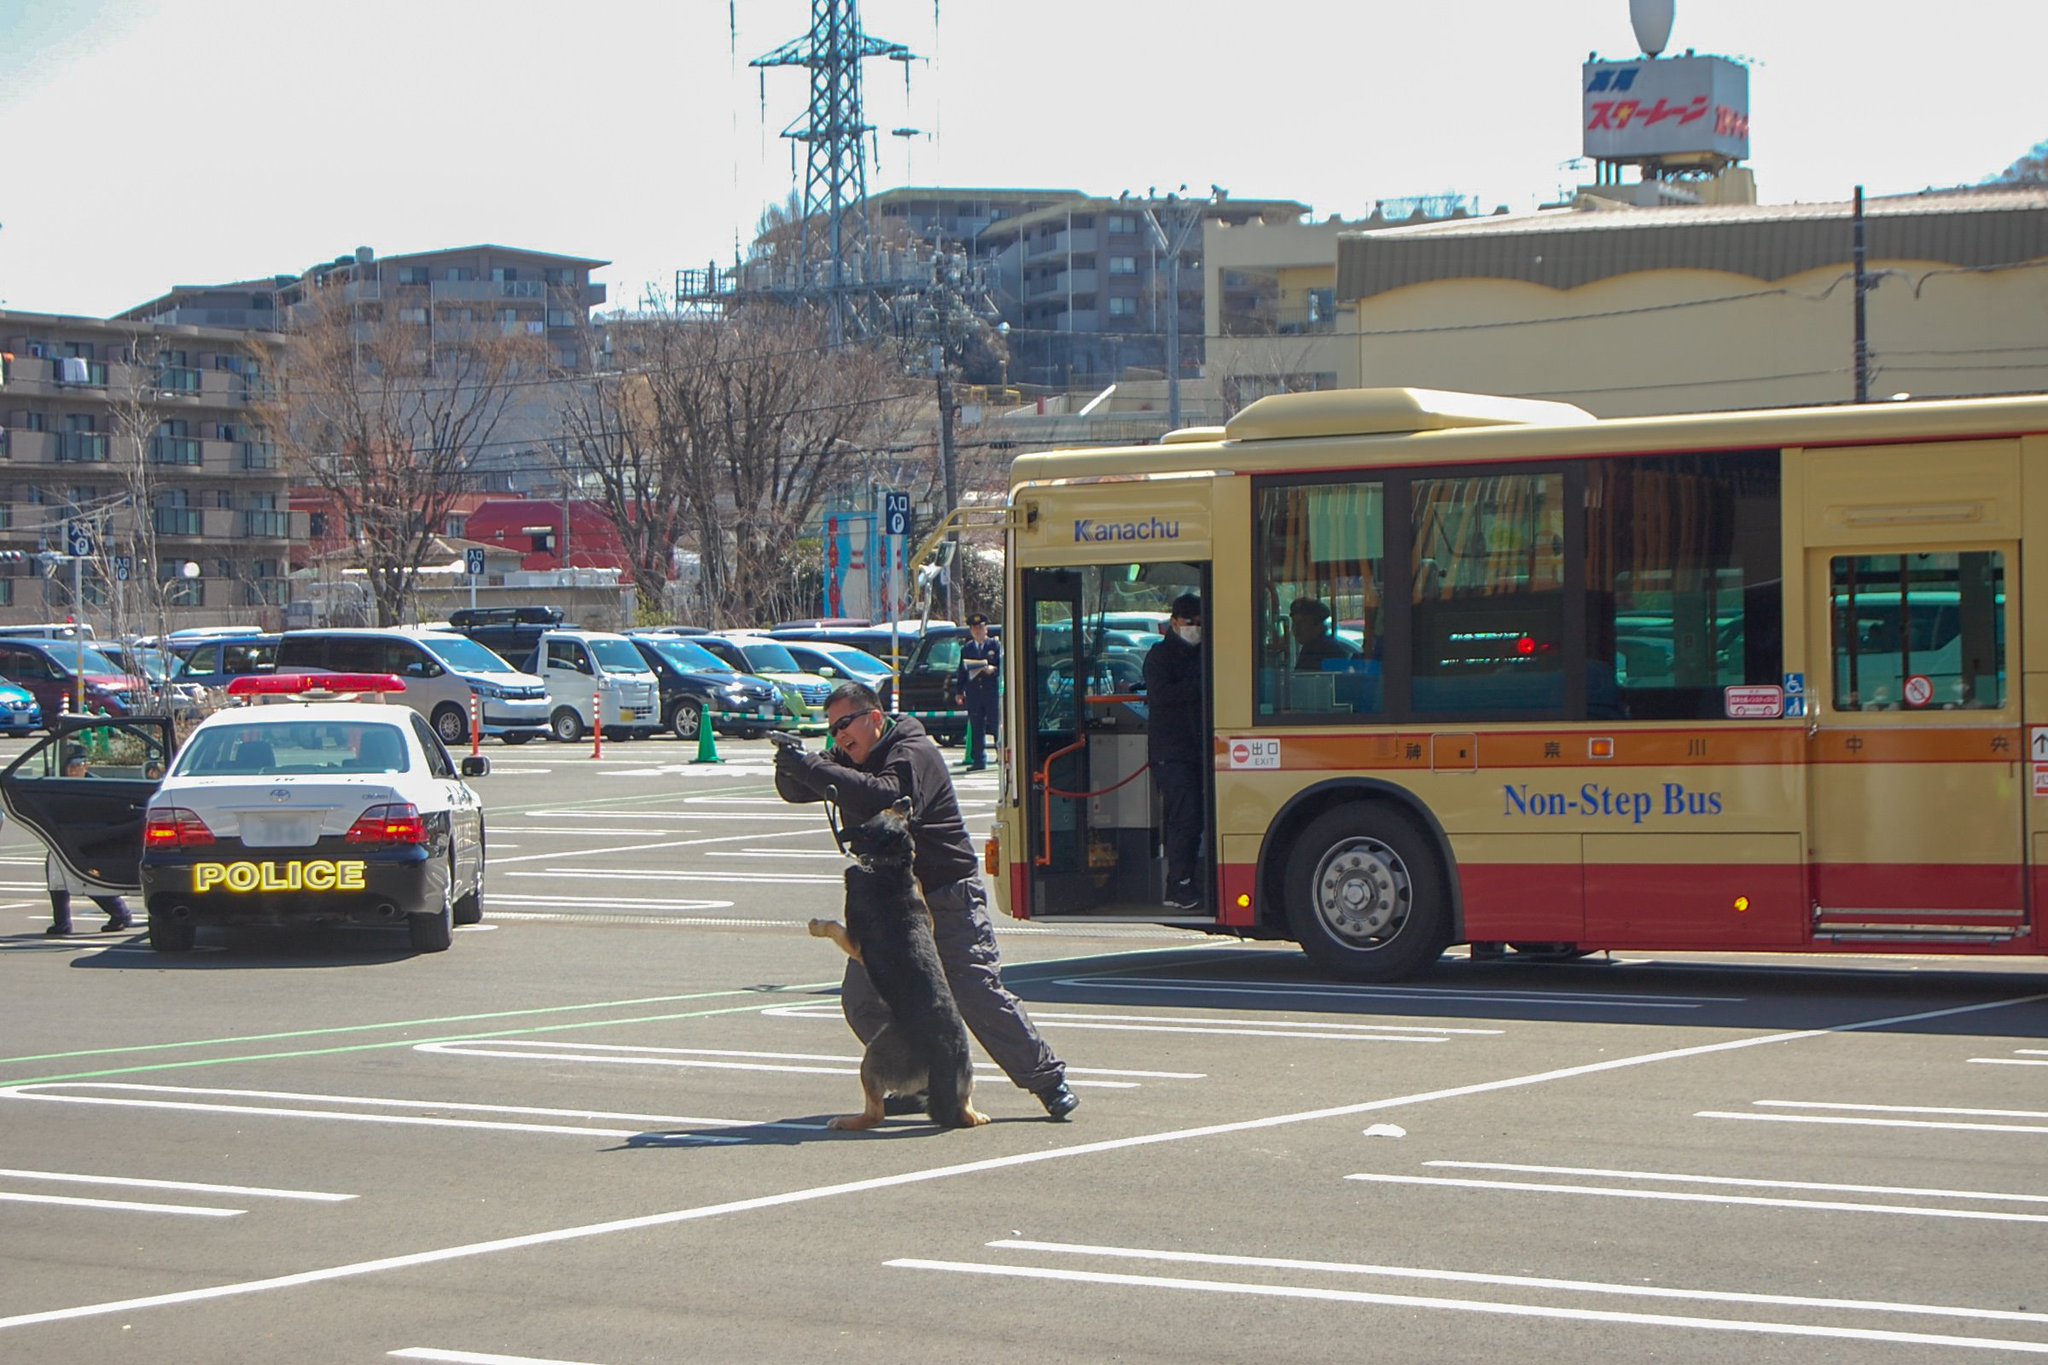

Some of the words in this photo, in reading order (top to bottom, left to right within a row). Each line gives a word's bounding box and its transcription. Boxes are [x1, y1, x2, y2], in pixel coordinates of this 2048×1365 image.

[1587, 96, 1708, 131] スターレーン
[888, 496, 907, 511] 入口
[1074, 517, 1180, 542] Kanachu
[470, 550, 483, 561] 入口
[1251, 741, 1278, 756] 出口
[1255, 757, 1275, 766] EXIT
[1503, 783, 1652, 824] Non-Step
[1662, 783, 1723, 816] Bus
[193, 860, 367, 892] POLICE
